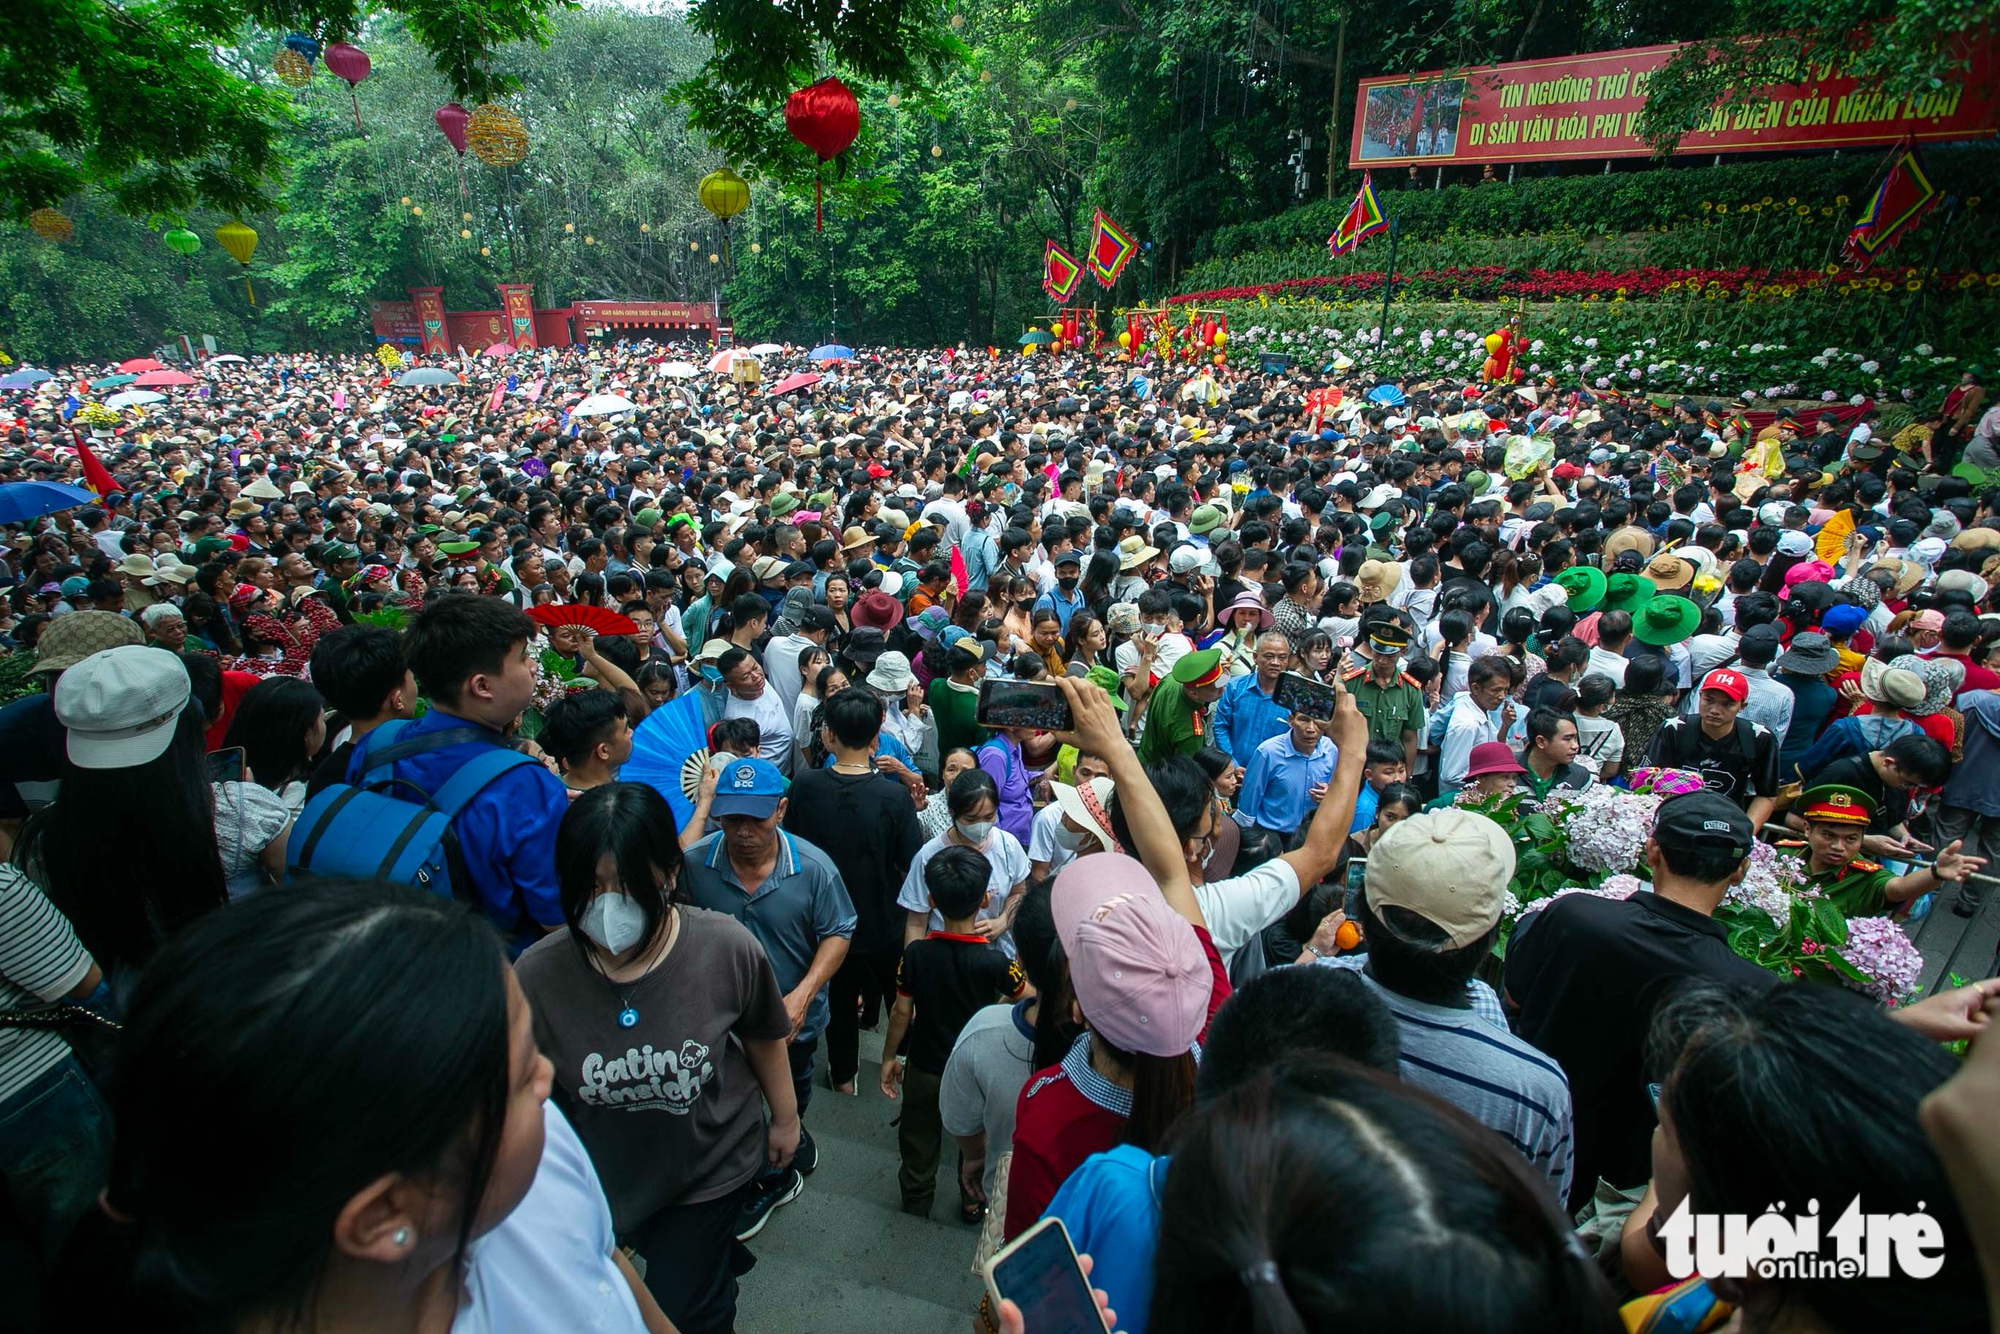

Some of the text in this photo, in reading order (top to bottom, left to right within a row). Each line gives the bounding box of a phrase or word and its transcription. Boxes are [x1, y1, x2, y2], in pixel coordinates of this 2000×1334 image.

[1499, 79, 1525, 108] TÍN
[1526, 73, 1592, 106] NGƯỠNG
[1596, 66, 1631, 100] THỜ
[1468, 123, 1486, 146] DI
[1487, 114, 1519, 145] SẢN
[1522, 114, 1554, 143] VĂN
[1555, 111, 1588, 142] HÓA
[1591, 113, 1622, 139] PHI
[1785, 88, 1830, 127] CỦA
[1715, 673, 1735, 685] 114
[582, 1044, 678, 1088] Gatin
